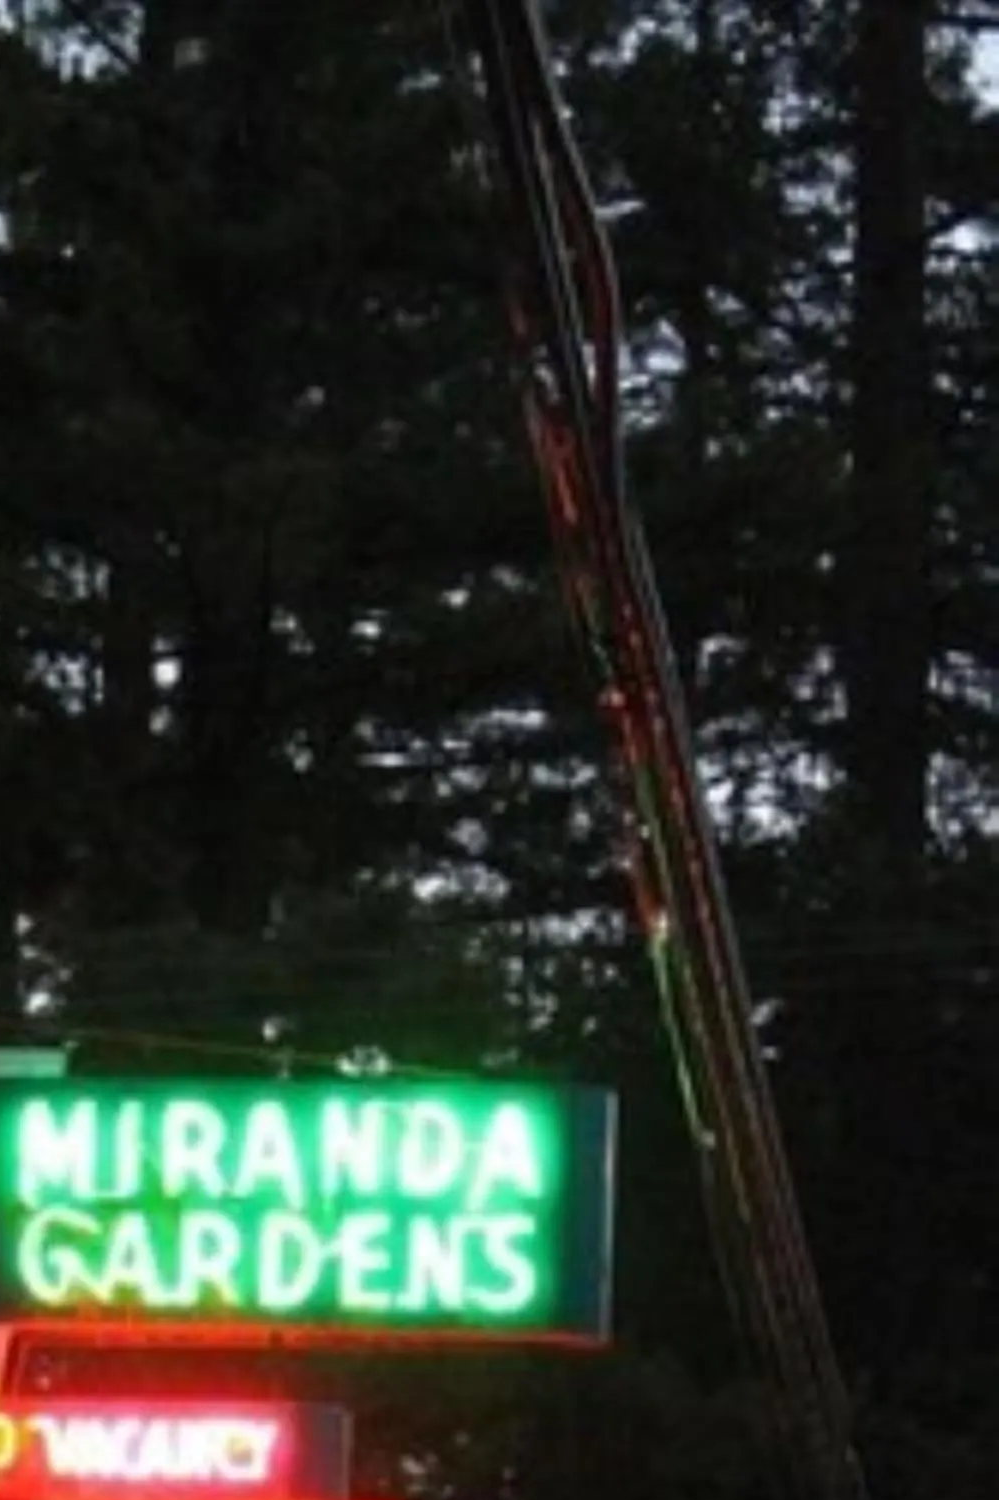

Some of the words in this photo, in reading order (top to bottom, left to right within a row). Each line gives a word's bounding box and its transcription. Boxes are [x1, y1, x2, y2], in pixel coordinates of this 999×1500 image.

[16, 1095, 544, 1207] MIRANDA
[16, 1206, 539, 1311] GARDENS
[27, 1414, 277, 1481] VACANCY
